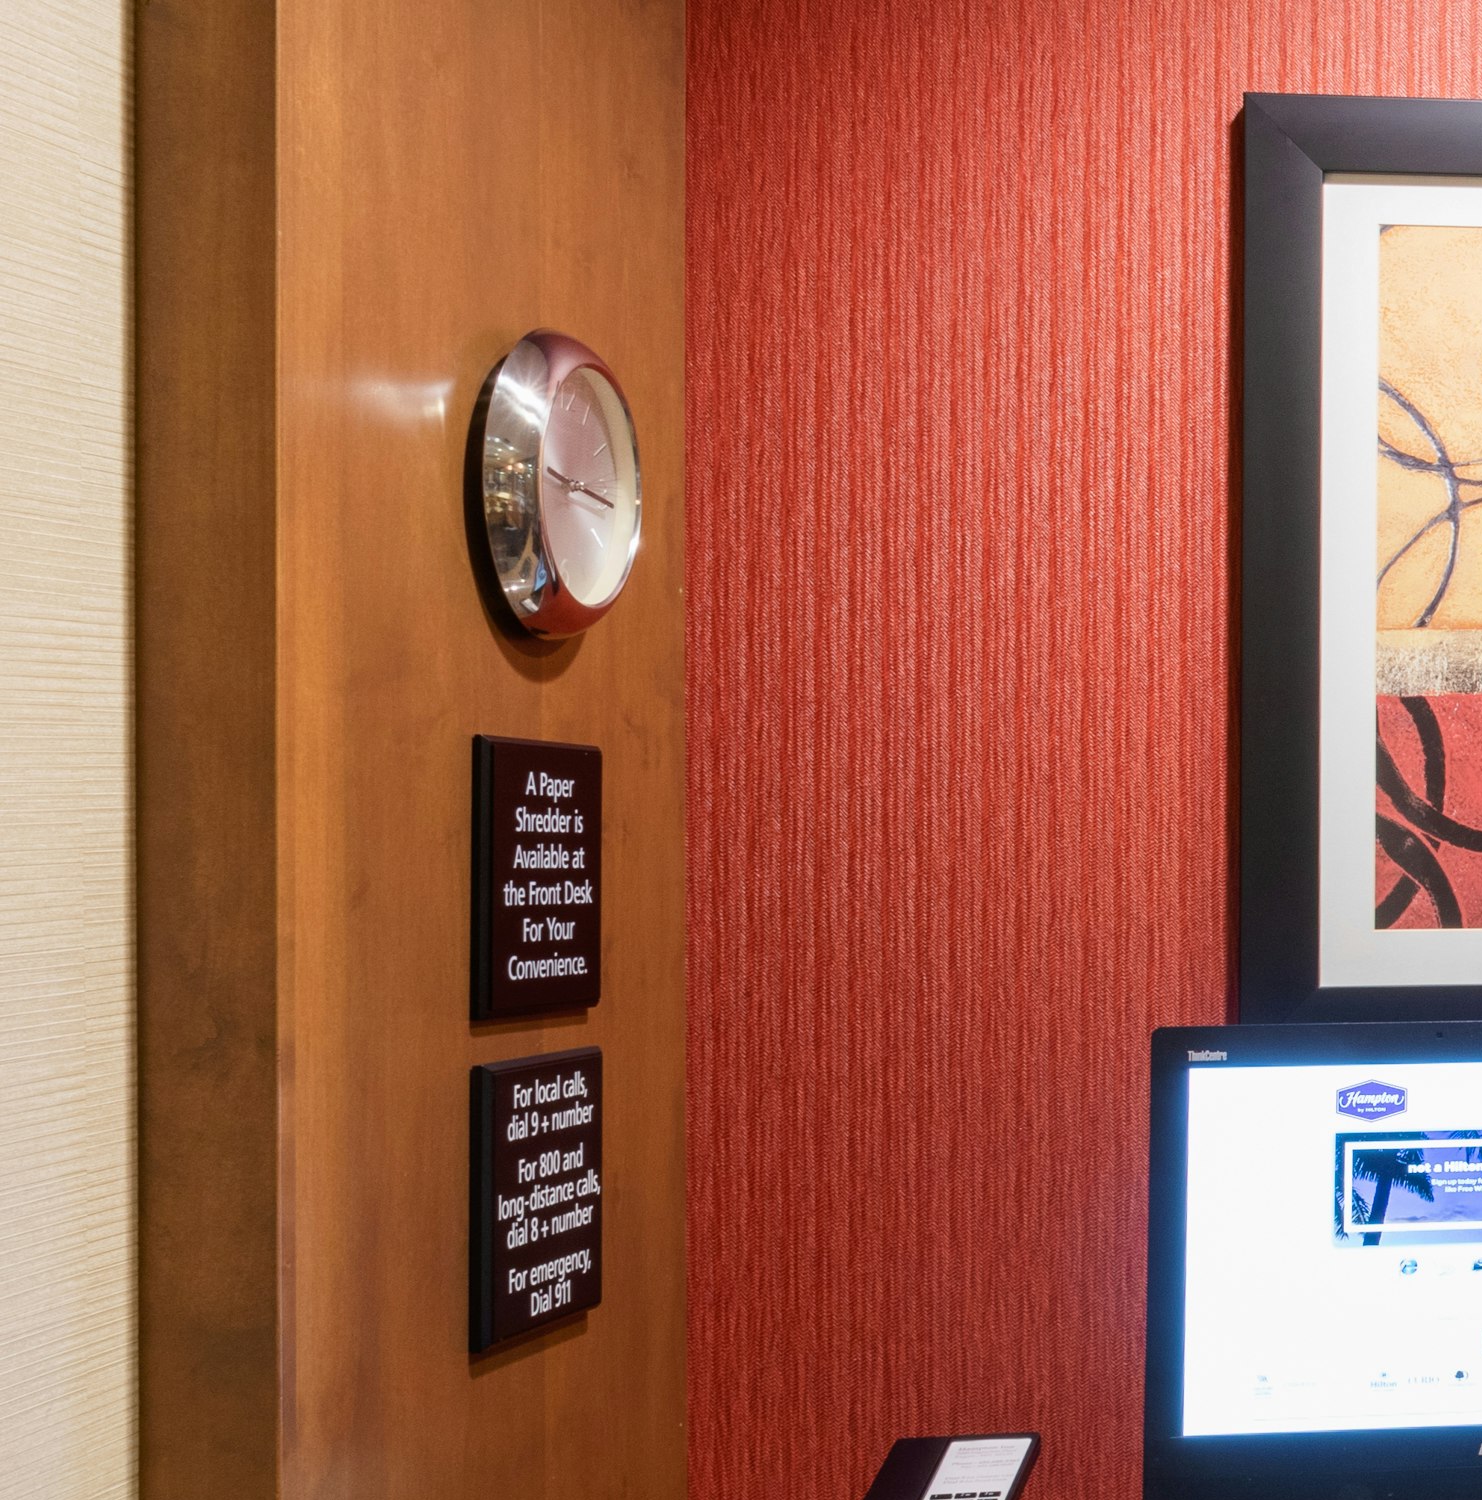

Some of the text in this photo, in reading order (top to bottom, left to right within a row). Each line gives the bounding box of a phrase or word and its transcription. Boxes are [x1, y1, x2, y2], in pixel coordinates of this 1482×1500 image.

[525, 771, 575, 803] A Paper
[515, 806, 584, 834] Shredder is
[513, 843, 585, 869] Available at
[503, 879, 593, 907] the Front Desk
[522, 916, 576, 943] For Your
[507, 952, 588, 981] Convenience.
[513, 1070, 588, 1109] For local calls,
[1338, 1090, 1406, 1108] Hampton
[507, 1101, 594, 1142] dial 9 + number
[518, 1142, 584, 1184] For 800 and
[1408, 1163, 1431, 1174] not
[1433, 1164, 1443, 1173] a
[498, 1168, 601, 1221] long-distance calls,
[507, 1204, 594, 1250] dial 8 + number
[508, 1248, 592, 1294] For emergency,
[530, 1279, 571, 1318] Dial 911
